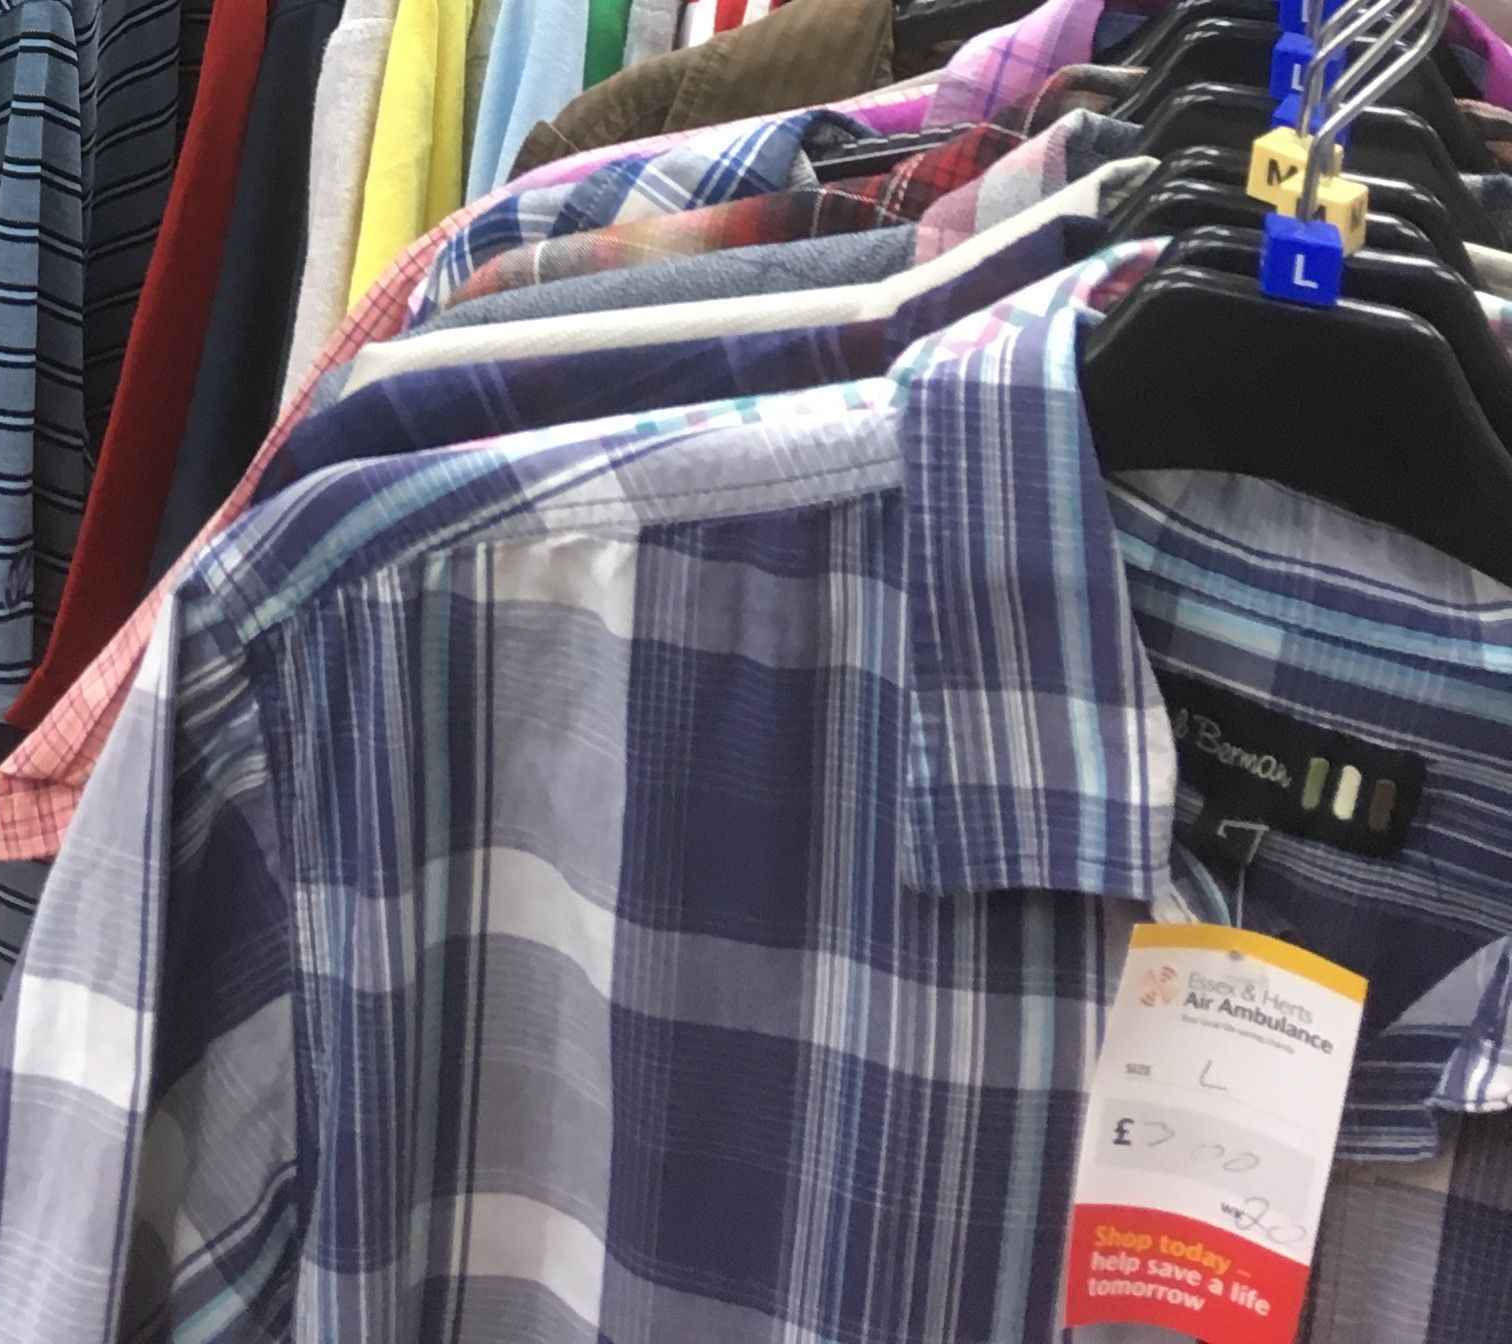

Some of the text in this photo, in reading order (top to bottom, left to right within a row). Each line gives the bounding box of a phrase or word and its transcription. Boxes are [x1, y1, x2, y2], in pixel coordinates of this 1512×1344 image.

[1292, 254, 1317, 288] L
[1188, 971, 1313, 1025] Essex & Herts
[1184, 991, 1213, 1010] Air
[1217, 997, 1334, 1055] Ambulance
[1199, 1059, 1229, 1092] L
[1113, 1117, 1136, 1146] £
[1095, 1224, 1231, 1276] Shop today
[1088, 1277, 1206, 1311] tomorrow
[1091, 1252, 1272, 1317] help save a life
